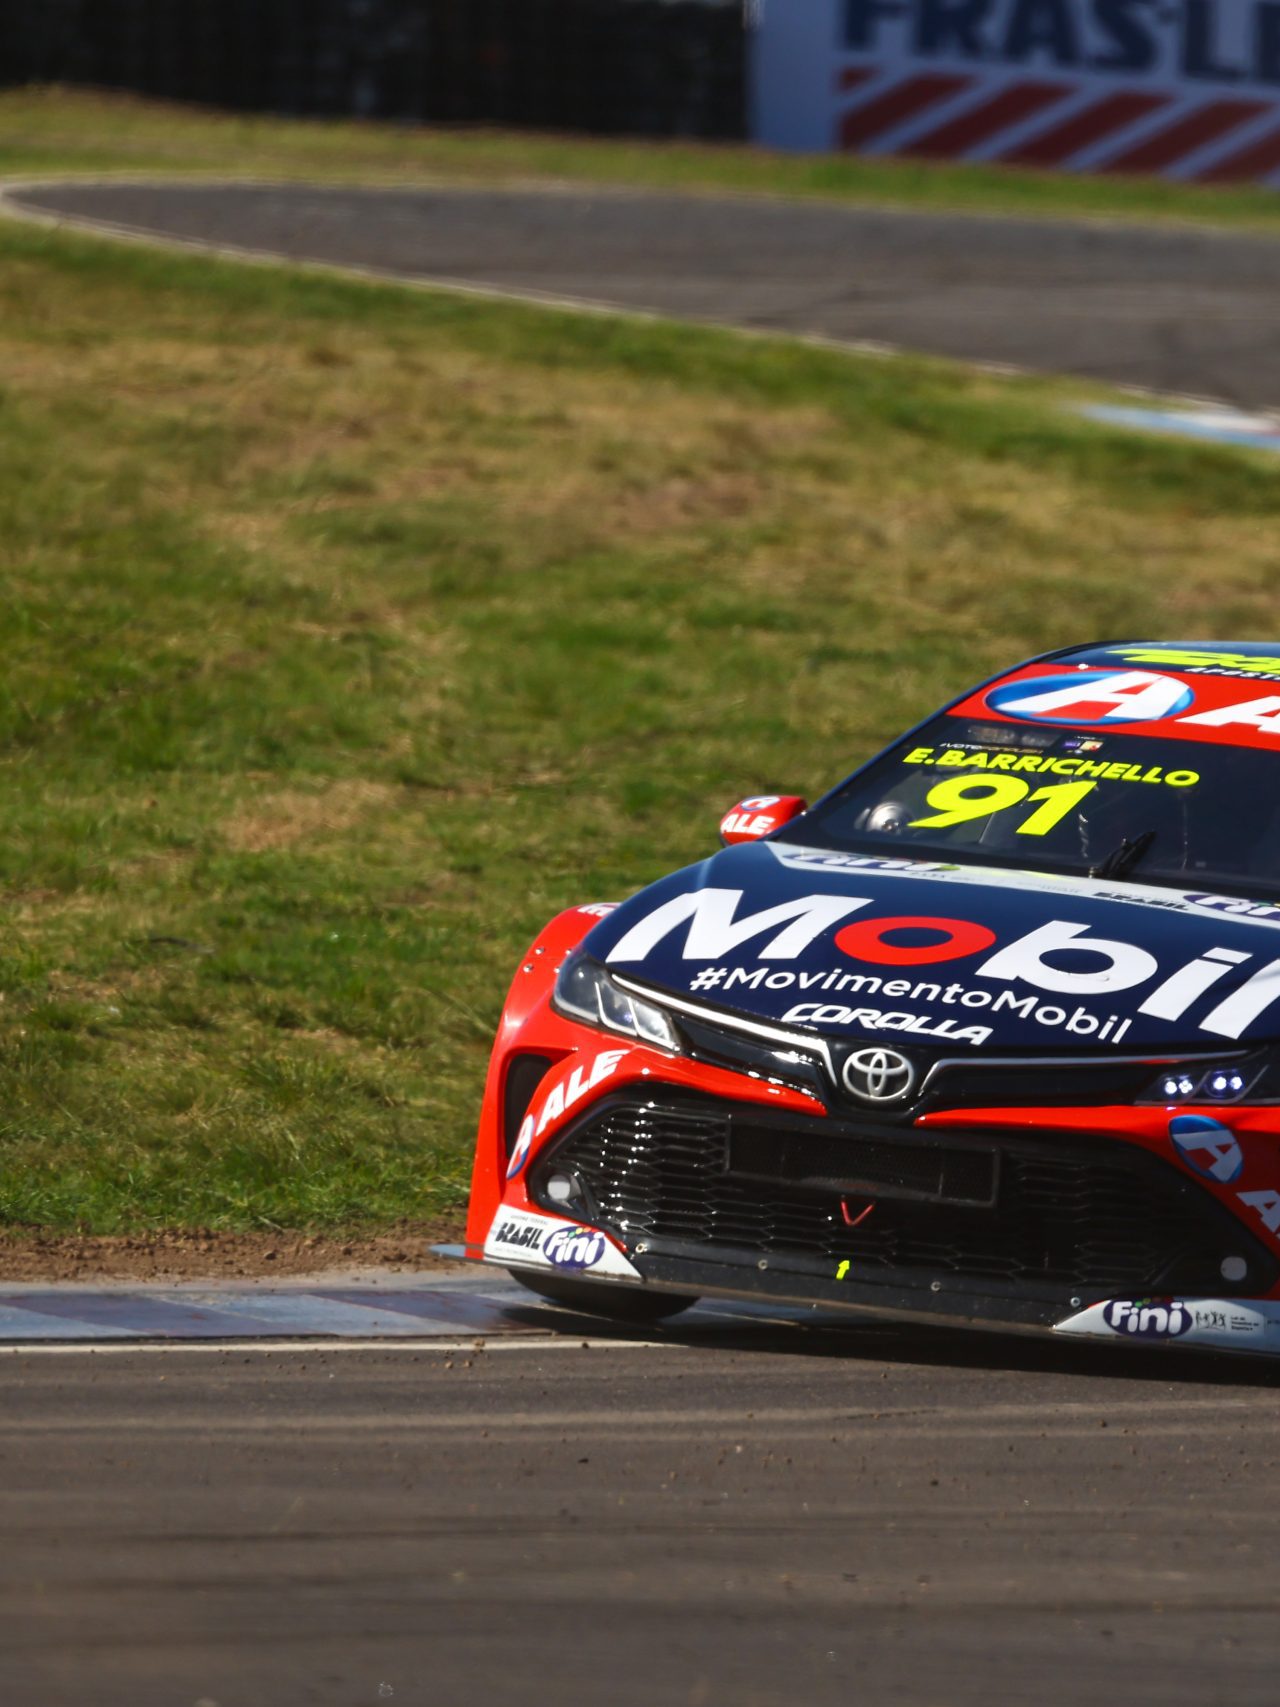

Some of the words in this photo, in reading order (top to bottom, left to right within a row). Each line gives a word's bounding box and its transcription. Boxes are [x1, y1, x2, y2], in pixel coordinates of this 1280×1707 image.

[902, 748, 1200, 786] E.BARRICHELLO
[721, 814, 775, 835] ALE
[907, 773, 1097, 836] 91
[690, 965, 1132, 1045] #MovimentoMobil
[781, 1003, 994, 1046] COROLLA
[535, 1049, 631, 1137] ALE
[545, 1231, 605, 1264] Fini
[1110, 1300, 1185, 1335] Fini
